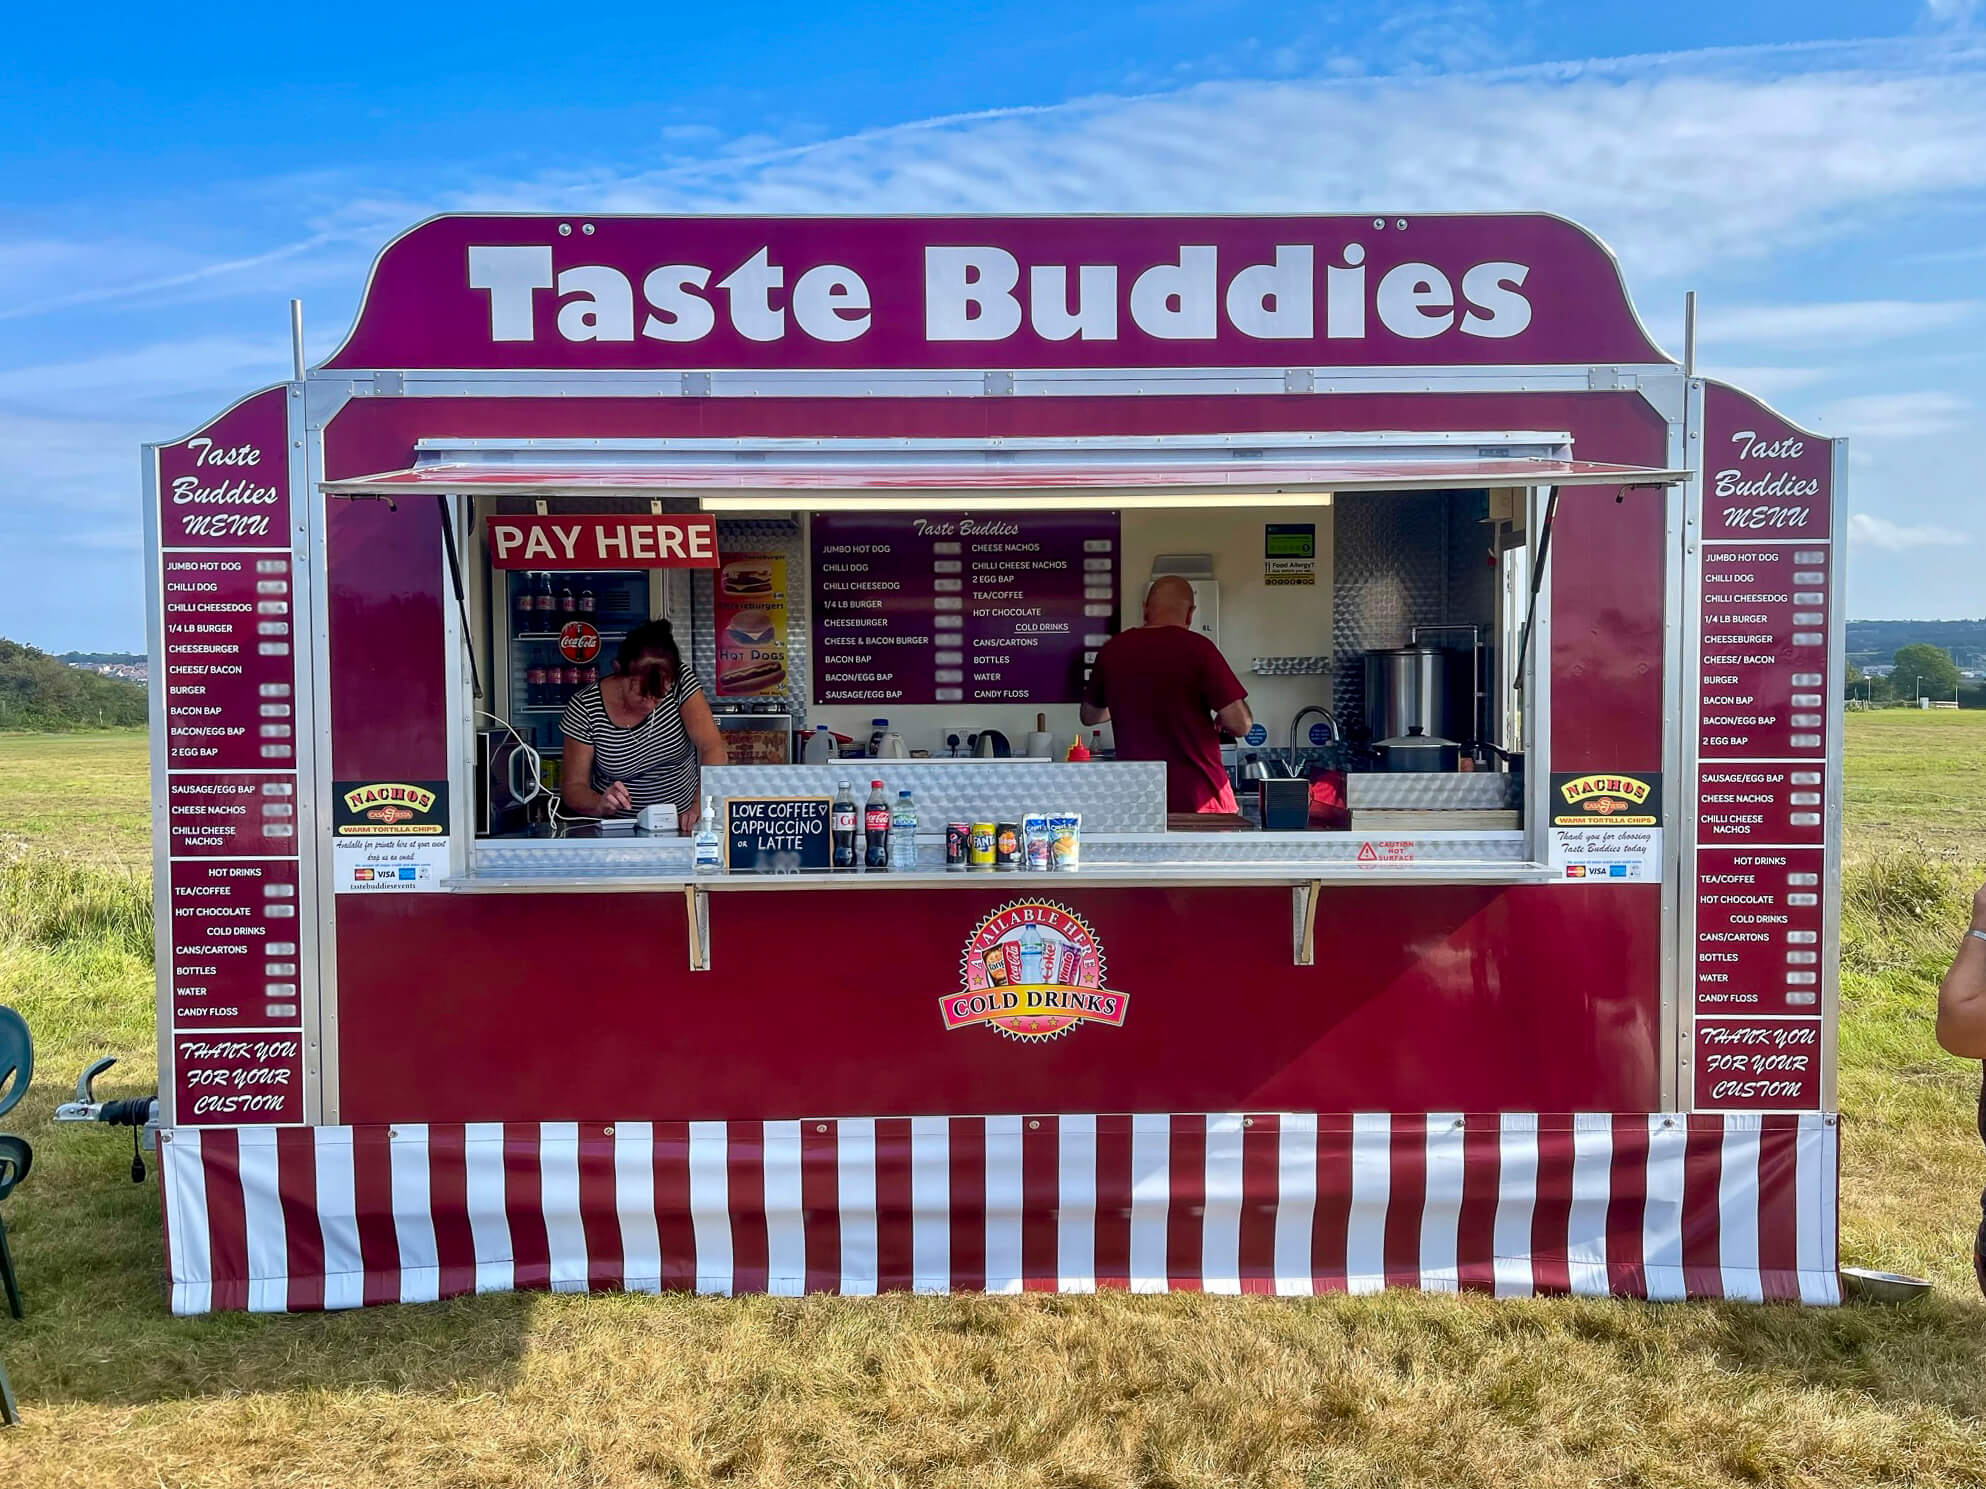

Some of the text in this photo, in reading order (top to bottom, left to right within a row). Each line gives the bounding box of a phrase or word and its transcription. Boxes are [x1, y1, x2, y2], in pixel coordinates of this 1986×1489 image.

[468, 242, 1532, 342] Taste Buddies
[1732, 430, 1806, 460] Taste
[187, 437, 260, 466] Taste
[1715, 469, 1819, 497] Buddies
[172, 476, 278, 504] Buddies
[1723, 506, 1809, 528] MENU
[182, 514, 270, 536] MENU
[913, 518, 1018, 536] Taste Buddies
[494, 524, 714, 560] PAY HERE
[971, 543, 1040, 552] CHEESE NACHOS
[167, 562, 242, 571] JUMBO HOT DOG
[972, 561, 1067, 570] CHILLI CHEESE NACHOS
[167, 582, 218, 591] CHILLI DOG
[973, 591, 1024, 600] TEA/COFFEE
[1704, 594, 1788, 603] CHILLI CHEESEDOG
[167, 603, 252, 612] CHILLI CHEESEDOG
[973, 608, 1041, 617] HOT CHOCOLATE
[824, 618, 888, 628] CHEESEBURGER
[1015, 623, 1038, 632] COLD
[168, 624, 233, 633] 1/4 LB BURGER
[824, 637, 856, 645] CHEESE
[866, 636, 895, 645] BACON
[896, 636, 929, 645] BURGER
[973, 638, 1038, 647] CANS/CARTONS
[1704, 635, 1773, 644] CHEESEBURGER
[168, 644, 239, 654] CHEESEBURGER
[974, 656, 1010, 664] BOTTLES
[1704, 655, 1775, 664] CHEESE/ BACON
[169, 665, 242, 674] CHEESE/ BACON
[973, 673, 1001, 681] WATER
[1704, 676, 1738, 684] BURGER
[170, 686, 206, 694] BURGER
[825, 690, 902, 699] SAUSAGE/EGG BAP
[974, 690, 1029, 698] CANDY FLOSS
[1703, 696, 1754, 705] BACON BAP
[170, 706, 222, 715] BACON BAP
[1703, 716, 1776, 725] BACON/EGG BAP
[170, 726, 245, 736] BACON/EGG BAP
[1702, 774, 1784, 783] SAUSAGE/EGG BAP
[171, 785, 256, 794] SAUSAGE/EGG BAP
[1566, 778, 1646, 799] NACHOS
[349, 788, 430, 808] NACHOS
[1701, 794, 1774, 803] CHEESE NACHOS
[171, 806, 246, 814] CHEESE NACHOS
[732, 803, 816, 818] LOVE COFFEE
[1700, 814, 1763, 823] CHILLI CHEESE
[172, 826, 236, 835] CHILLI CHEESE
[1713, 825, 1750, 834] NACHOS
[185, 837, 223, 846] NACHOS
[1557, 831, 1651, 843] Thank you for choosing
[758, 836, 803, 850] LATTE
[1561, 843, 1647, 854] Taste Buddies today
[1734, 856, 1786, 865] HOT DRINKS
[208, 868, 262, 877] HOT DRINKS
[1700, 874, 1755, 884] TEA/COFFEE
[175, 886, 231, 896] TEA/COFFEE
[1700, 895, 1774, 904] HOT CHOCOLATE
[175, 907, 251, 916] HOT CHOCOLATE
[1730, 915, 1788, 924] COLD DRINKS
[206, 927, 266, 936] COLD DRINKS
[970, 908, 1096, 969] AVAILABLE HERE
[1699, 932, 1770, 942] CANS/CARTONS
[176, 945, 248, 955] CANS/CARTONS
[1699, 953, 1739, 962] BOTTLES
[176, 966, 217, 975] BOTTLES
[1699, 974, 1728, 982] WATER
[176, 987, 207, 996] WATER
[1698, 994, 1758, 1002] CANDY FLOSS
[952, 990, 1116, 1018] COLD DRINKS
[177, 1007, 238, 1016] CANDY FLOSS
[1700, 1028, 1816, 1048] THANK YOU
[179, 1041, 297, 1062] THANK YOU
[1707, 1054, 1808, 1074] FOR YOUR
[187, 1068, 291, 1090] FOR YOUR
[1712, 1080, 1802, 1099] CUSTOM
[194, 1094, 285, 1114] CUSTOM
